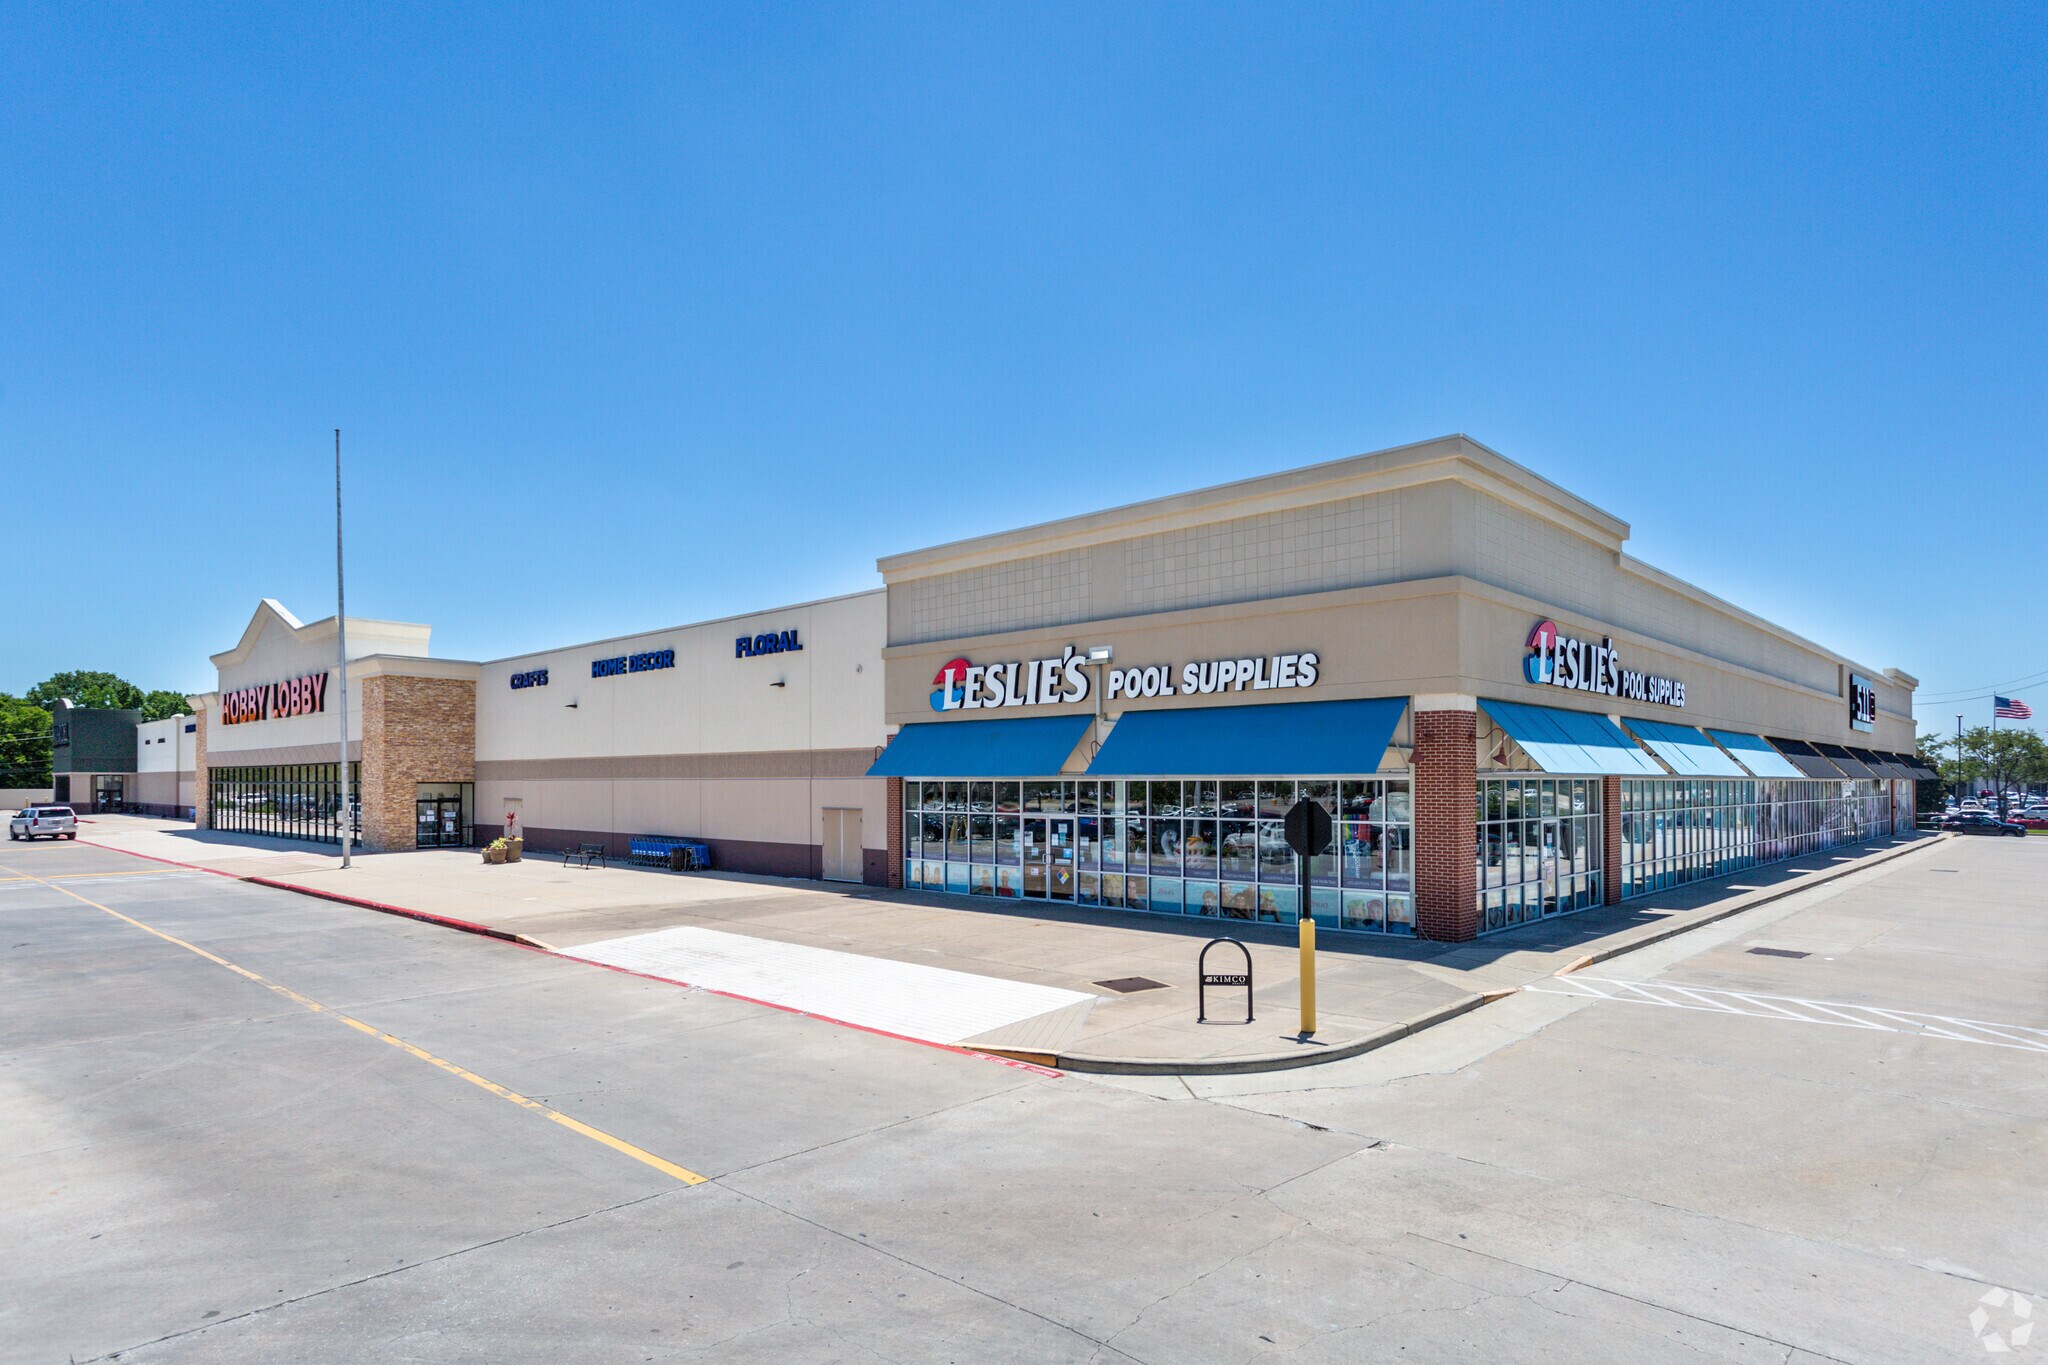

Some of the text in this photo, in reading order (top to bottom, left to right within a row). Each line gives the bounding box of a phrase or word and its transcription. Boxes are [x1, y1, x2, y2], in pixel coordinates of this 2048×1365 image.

[736, 629, 803, 658] FLORAL
[592, 649, 675, 679] HOME DECOR
[943, 645, 1320, 710] LESLIE'S POOL SUPPLIES
[1538, 629, 1686, 708] LESLIE'S POOL SUPPLIES
[510, 669, 549, 690] CRAFTS
[222, 672, 328, 726] HOBBY LOBBY
[1213, 975, 1246, 983] KIMCO
